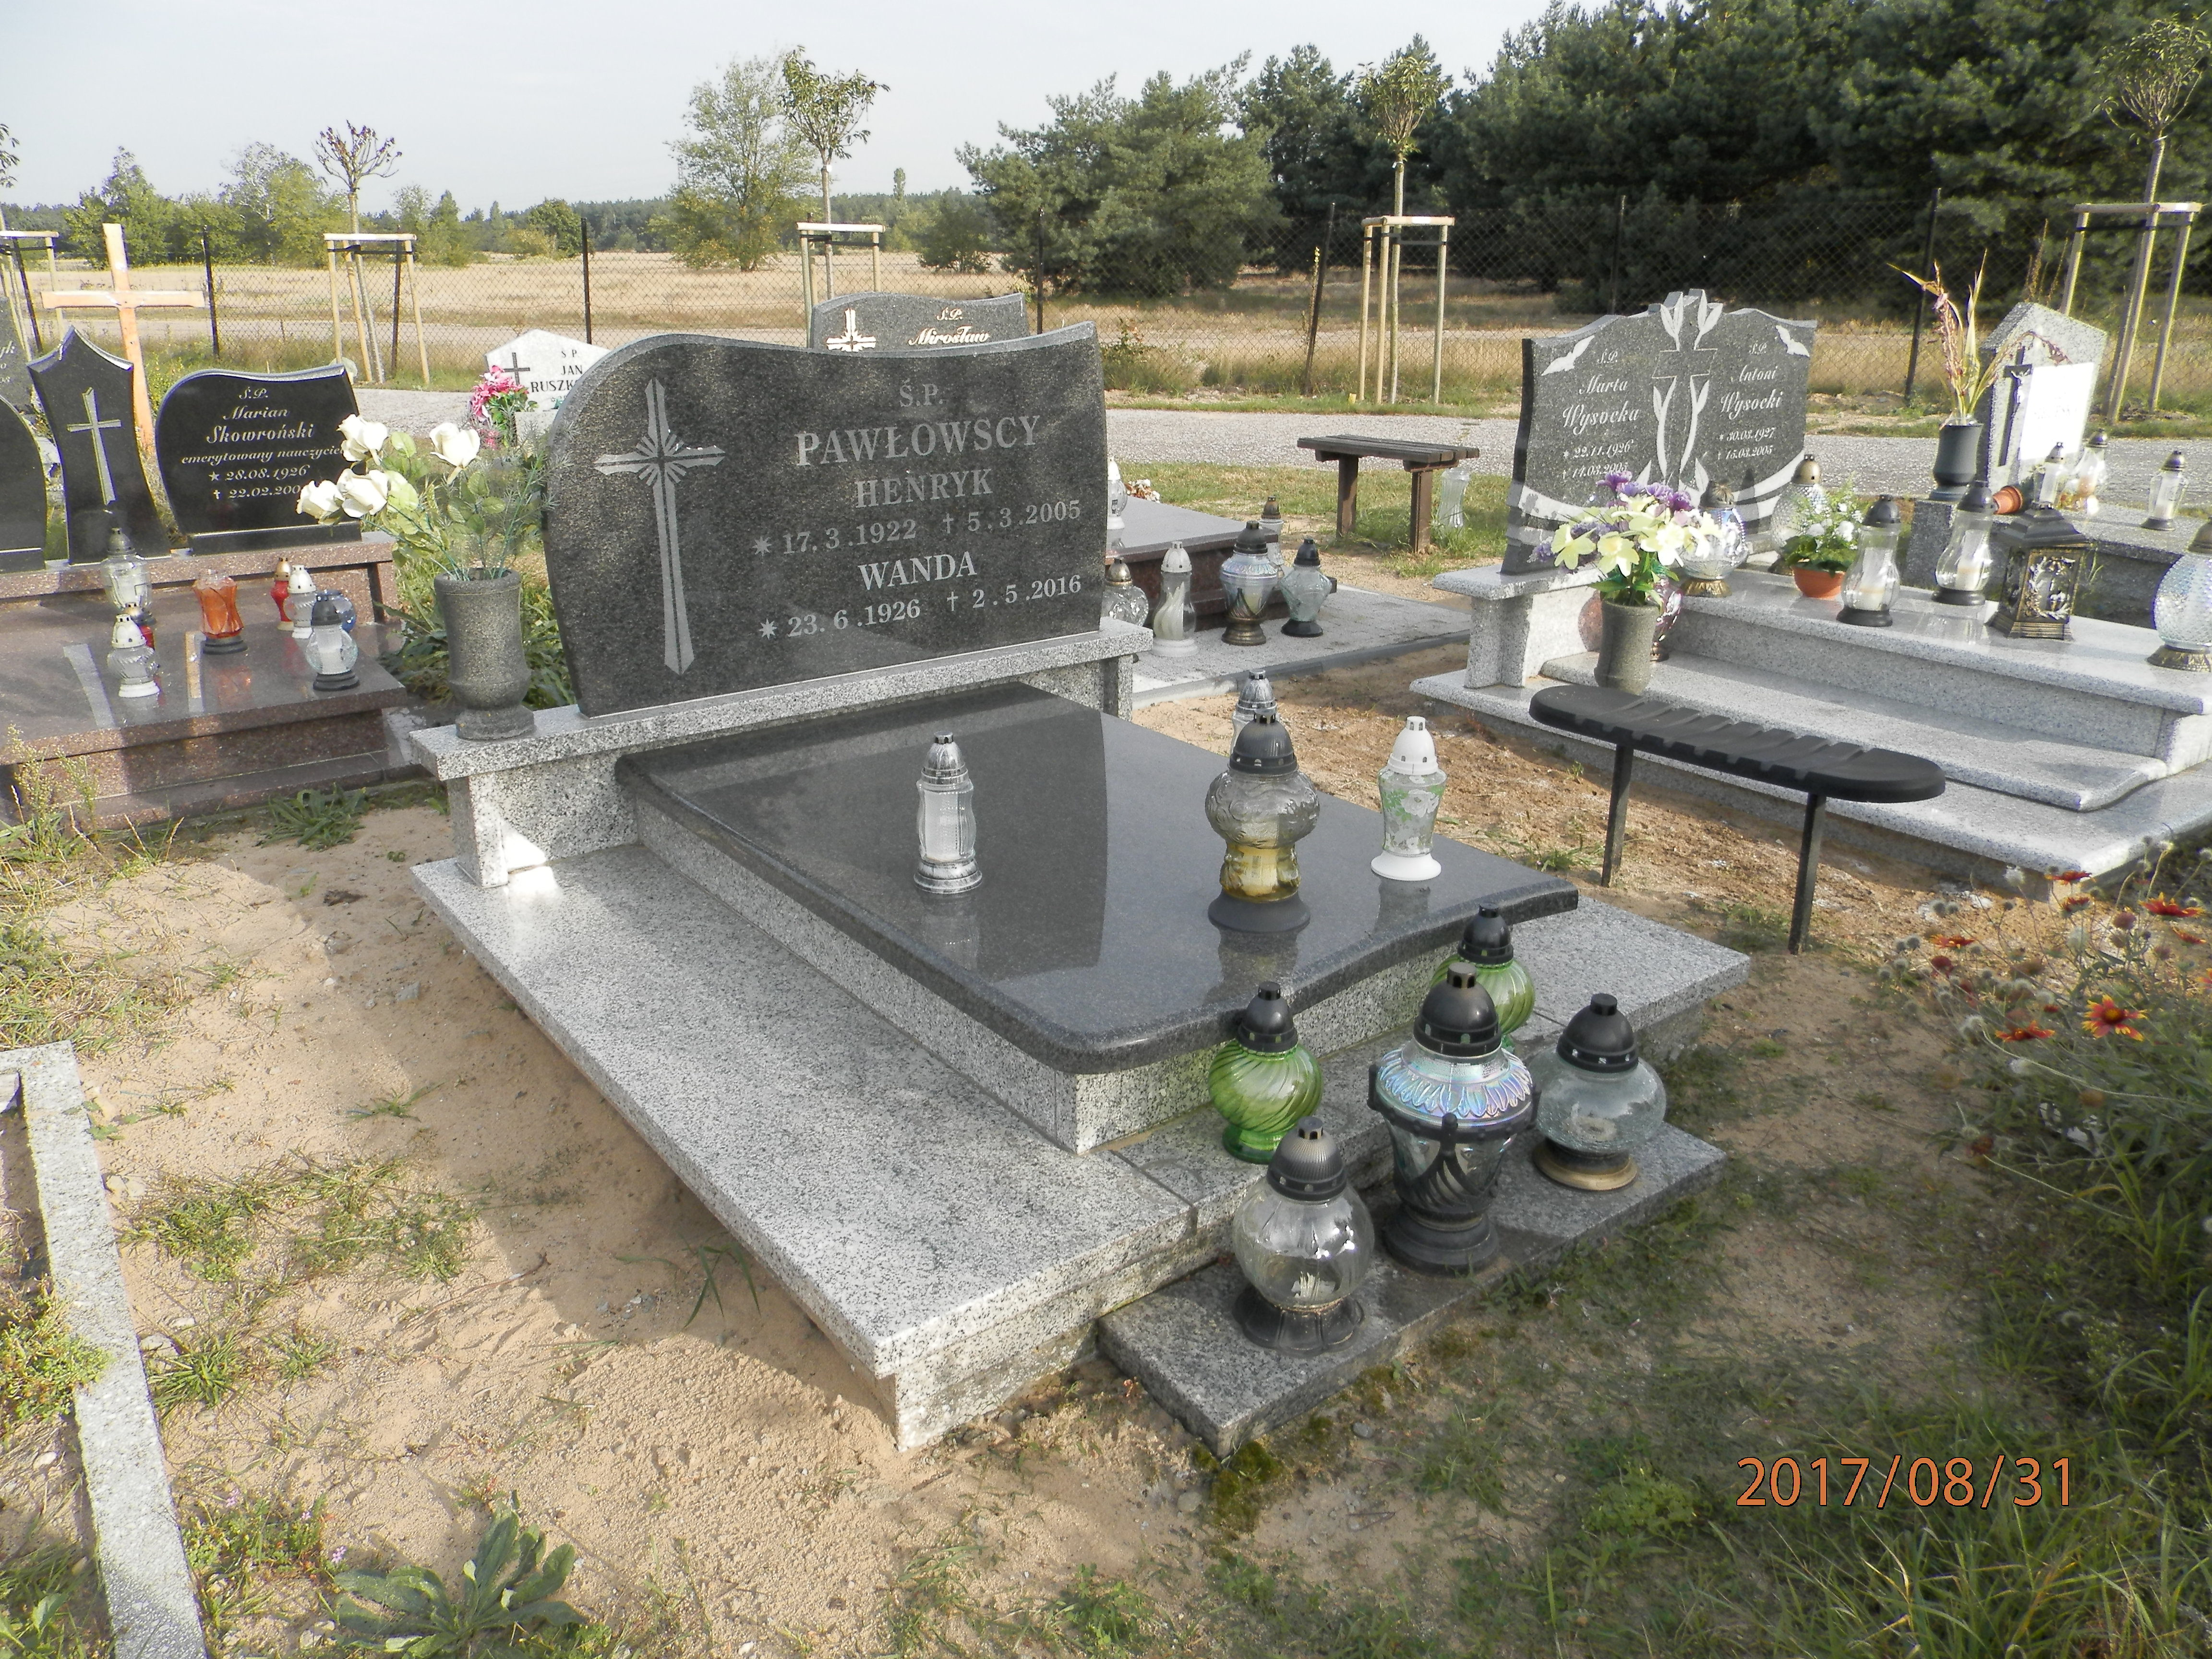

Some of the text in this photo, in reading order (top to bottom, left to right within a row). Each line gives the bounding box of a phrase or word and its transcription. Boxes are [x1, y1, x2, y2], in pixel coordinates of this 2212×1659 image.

[908, 326, 990, 346] Mirosław
[561, 365, 583, 375] JAN
[530, 380, 574, 393] RUSZK
[1579, 374, 1628, 395] Marta
[222, 405, 289, 420] Marian
[1720, 389, 1783, 420] Wysocki
[1563, 400, 1639, 435] Wysocka
[206, 421, 313, 444] Skowroński
[794, 415, 1040, 466] PAWŁOWSCY
[181, 450, 273, 466] emerytowany
[225, 464, 310, 481] 28.08.1926
[229, 485, 301, 499] 22.02.200
[854, 469, 993, 508] HENRYK
[857, 551, 977, 591] WANDA
